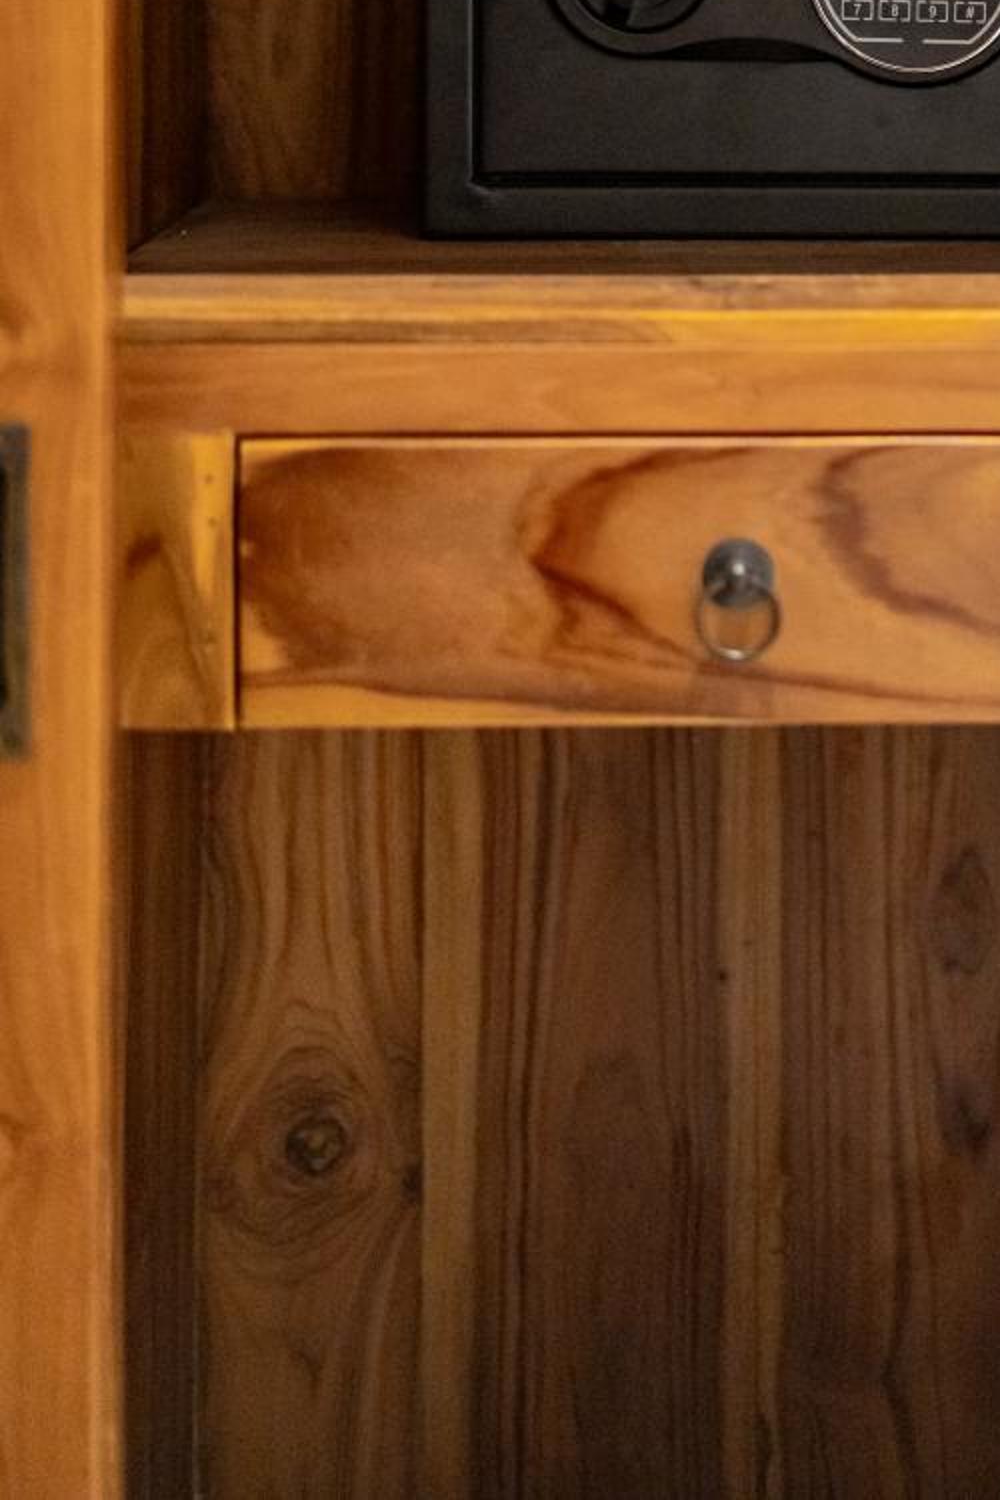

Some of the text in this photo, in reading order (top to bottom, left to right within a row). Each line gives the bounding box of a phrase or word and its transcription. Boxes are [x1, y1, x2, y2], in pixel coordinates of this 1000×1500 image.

[853, 3, 862, 15] 7
[891, 4, 899, 17] 8
[929, 5, 937, 18] 9
